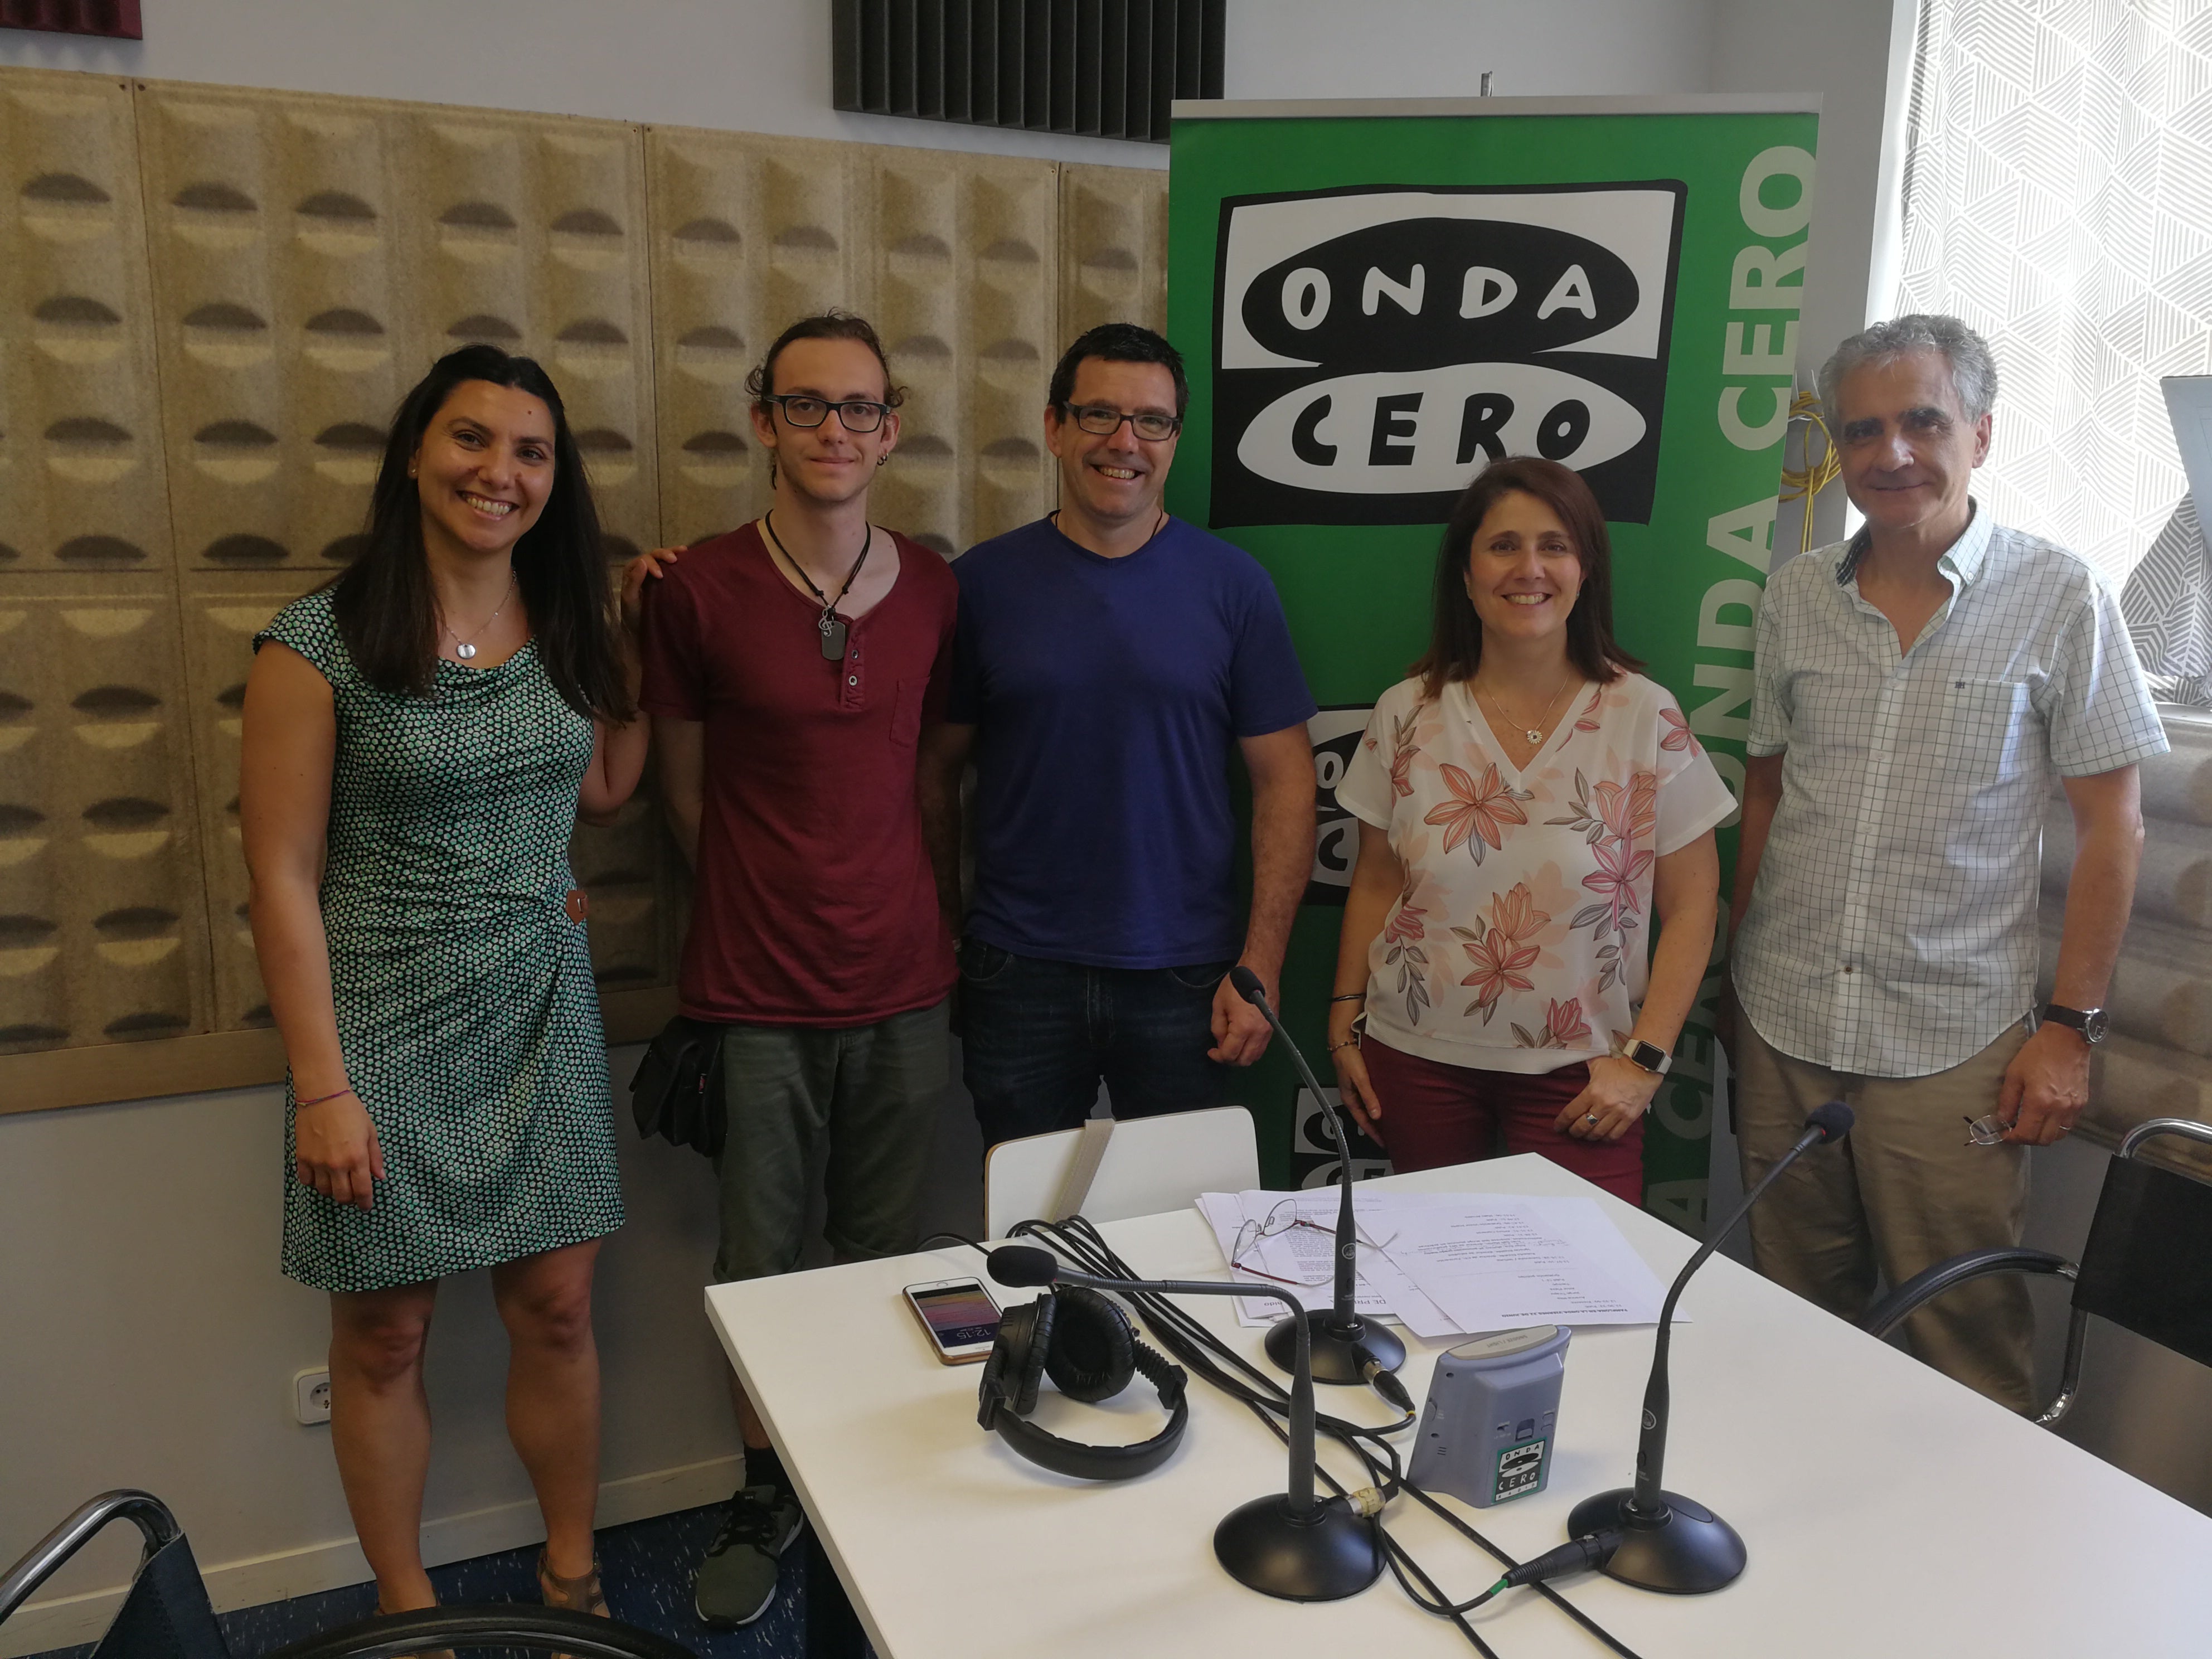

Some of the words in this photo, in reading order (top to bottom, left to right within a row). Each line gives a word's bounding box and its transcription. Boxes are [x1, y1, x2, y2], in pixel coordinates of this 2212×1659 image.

[1282, 263, 1597, 330] ONDA
[1718, 144, 1817, 451] CERO
[1291, 392, 1590, 467] CERO
[957, 1329, 991, 1339] 12:15
[1506, 1444, 1539, 1461] ONDA
[1498, 1472, 1536, 1491] CERO
[1498, 1483, 1535, 1498] RADIO
